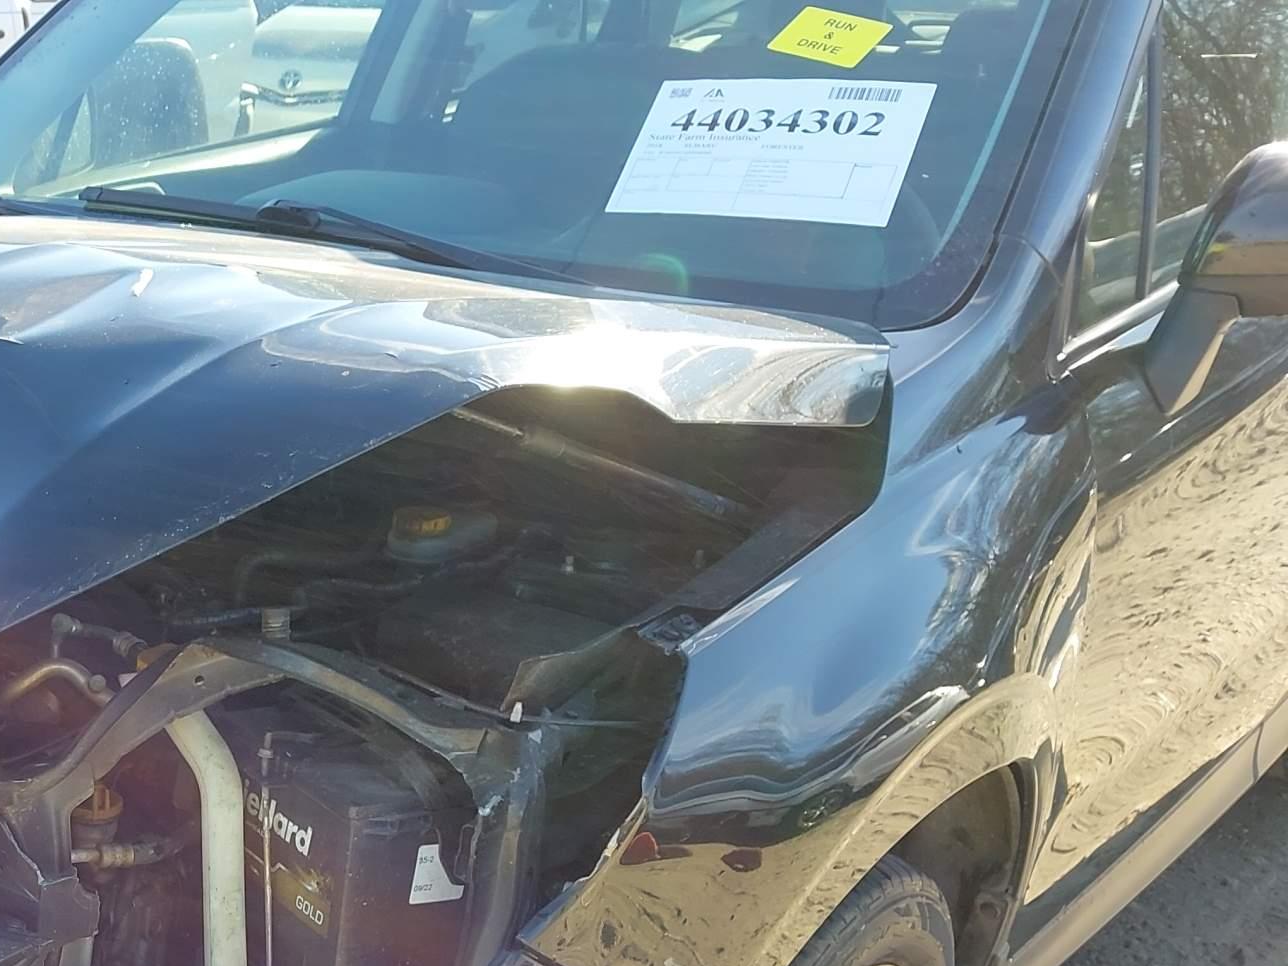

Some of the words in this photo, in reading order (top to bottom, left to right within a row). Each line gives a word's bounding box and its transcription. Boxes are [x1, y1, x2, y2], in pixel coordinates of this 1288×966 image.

[824, 18, 857, 31] RUN
[824, 31, 834, 40] &
[796, 38, 843, 55] DRIVE
[670, 108, 886, 136] 44034302
[295, 895, 324, 925] GOLD
